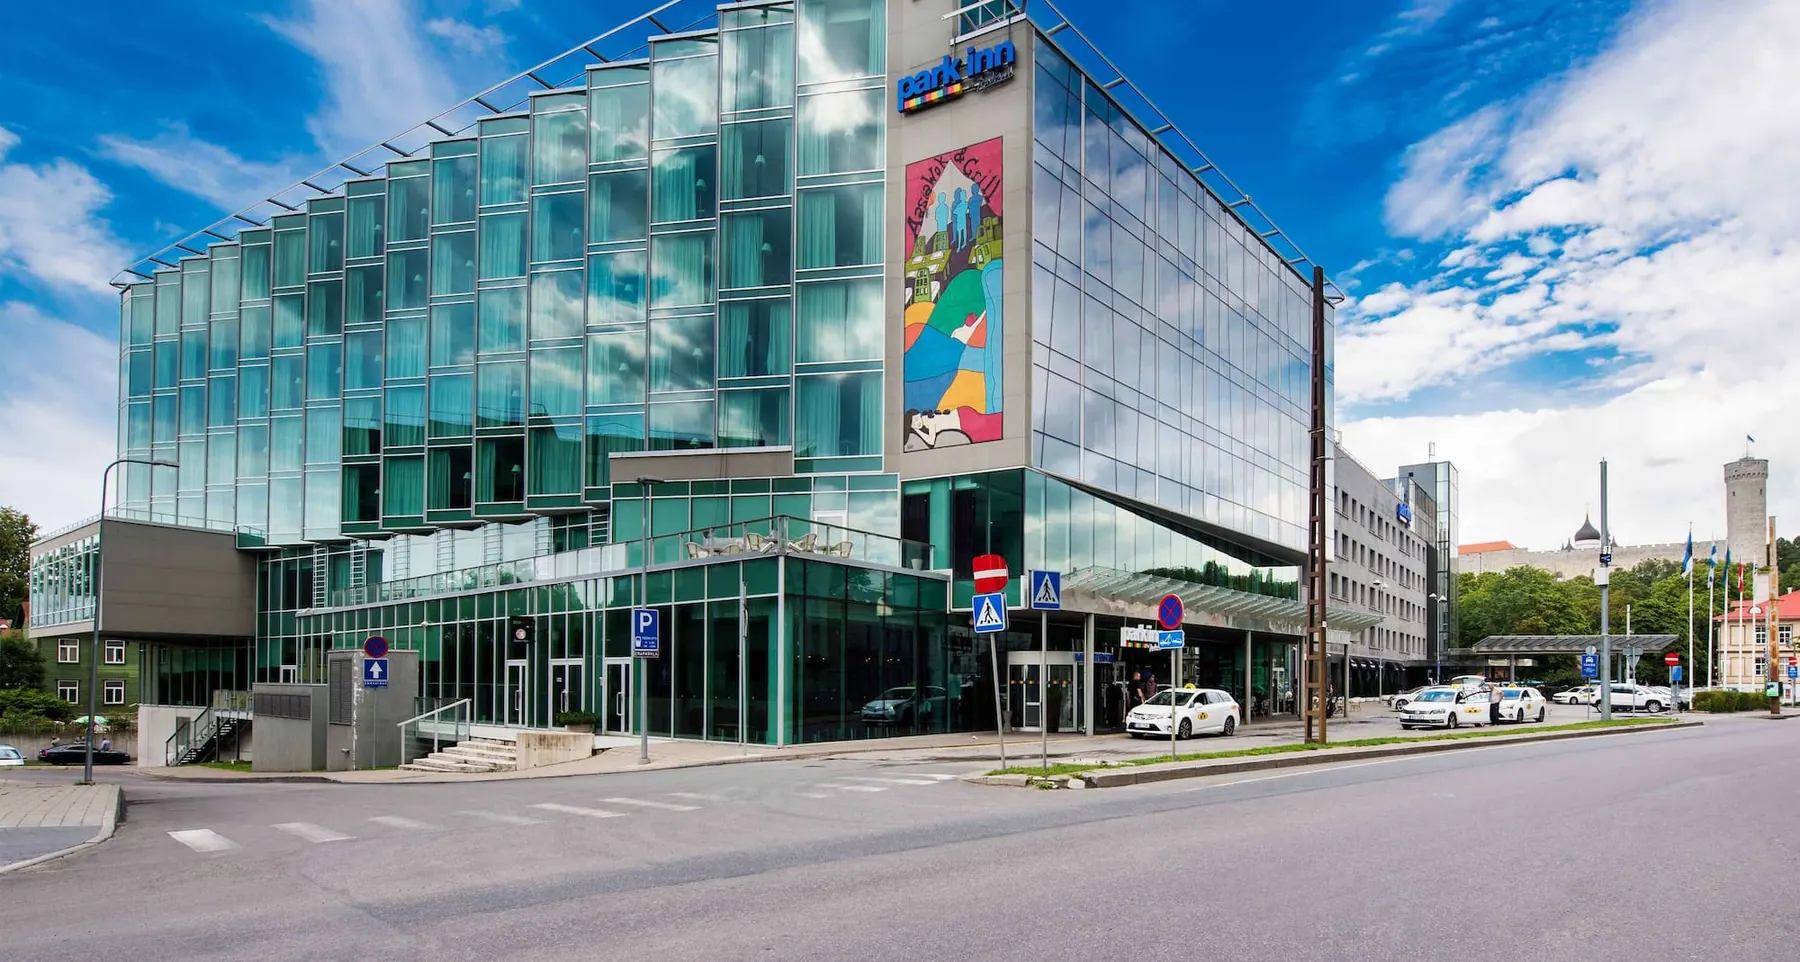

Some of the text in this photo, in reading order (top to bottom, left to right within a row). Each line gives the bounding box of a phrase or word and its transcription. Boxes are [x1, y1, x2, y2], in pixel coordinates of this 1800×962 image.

[897, 54, 963, 113] park
[966, 39, 1016, 79] inn
[921, 155, 949, 187] Wok
[963, 157, 1001, 204] Grill
[640, 612, 653, 633] P
